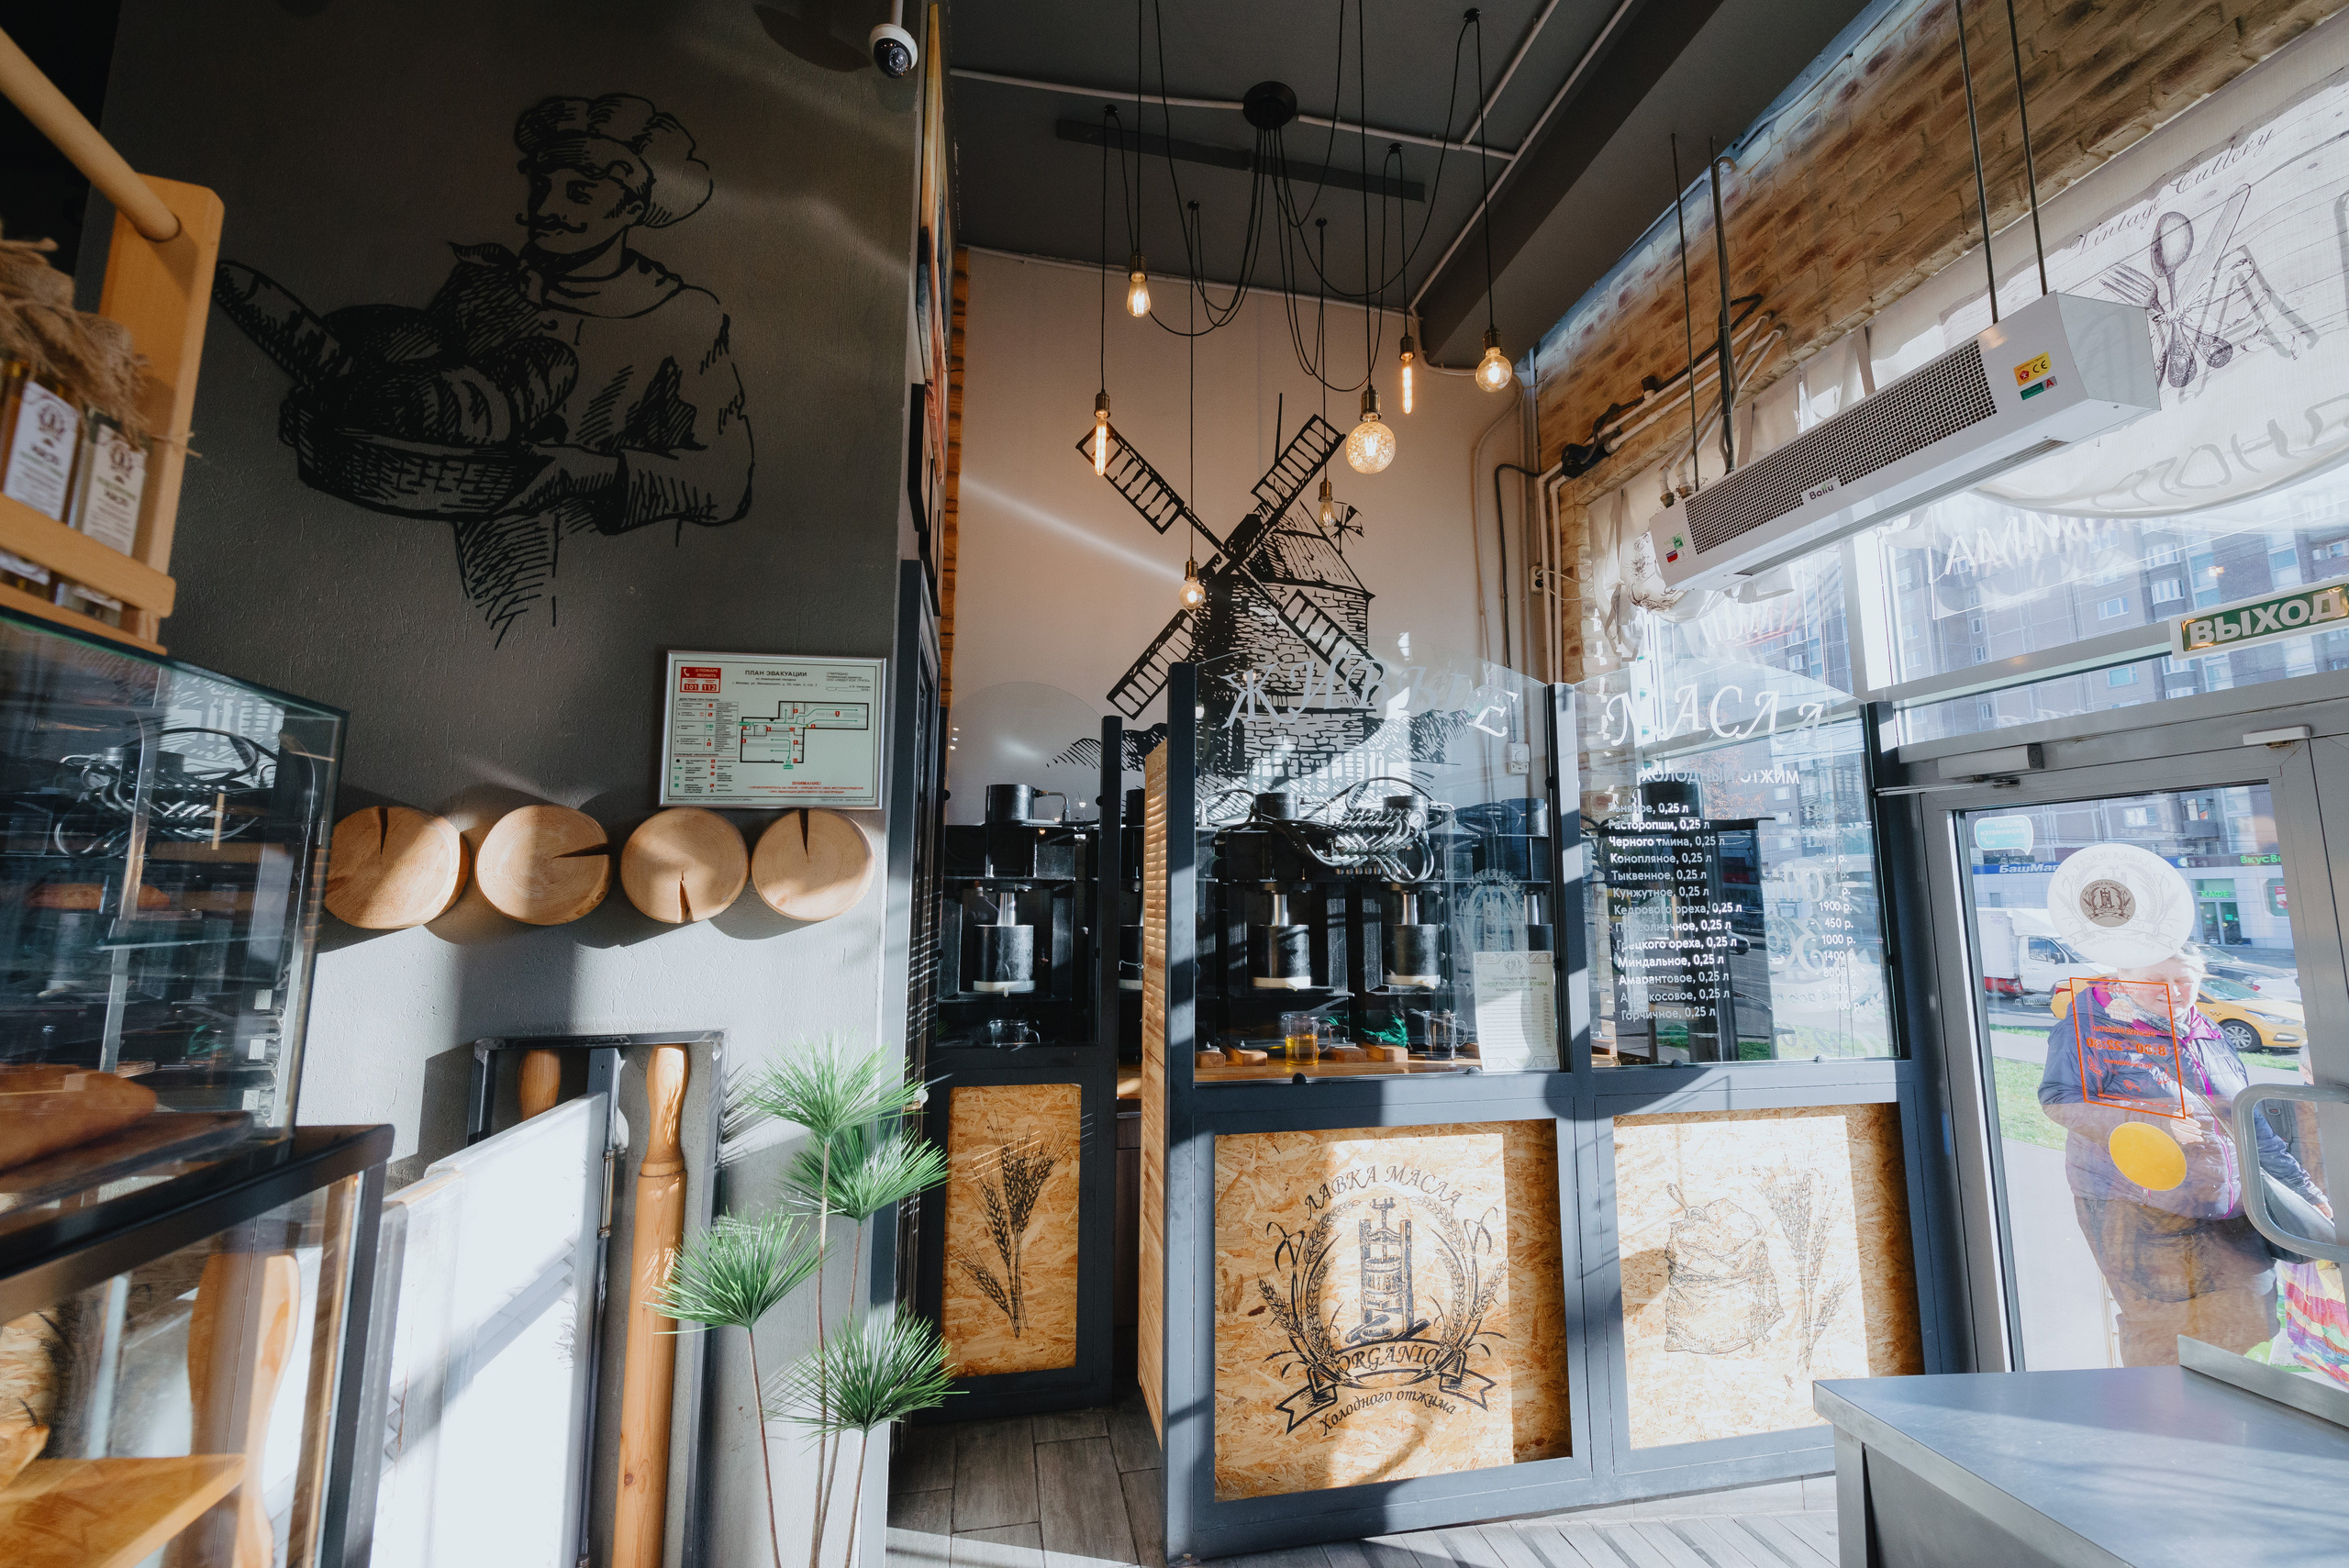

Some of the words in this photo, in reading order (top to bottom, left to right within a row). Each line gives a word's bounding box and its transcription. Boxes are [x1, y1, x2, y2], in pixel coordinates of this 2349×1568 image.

[2070, 197, 2160, 255] Vintage
[2169, 128, 2274, 194] Cutlery
[1809, 484, 1834, 500] Ballu
[2188, 591, 2344, 648] ВЫХОД
[1220, 651, 1519, 738] ЖИВЫЕ
[1606, 683, 1825, 749] МАСЛА
[1658, 803, 1680, 815] 0,25
[1608, 819, 1677, 832] Расторопши,
[1679, 819, 1701, 831] 0,25
[1609, 836, 1654, 849] Черного
[1655, 838, 1693, 848] тмина,
[1695, 836, 1717, 848] 0,25
[1609, 852, 1679, 864] Конопляное,
[1681, 852, 1703, 864] 0,25
[1611, 870, 1674, 881] Тыквенное,
[1676, 869, 1698, 881] 0,25
[1612, 887, 1676, 901] Кунжутное,
[1678, 886, 1700, 898] 0,25
[2200, 890, 2230, 898] КАФЕ
[1614, 905, 1672, 917] Кедрового
[1675, 905, 1710, 917] ореха,
[1711, 903, 1733, 915] 0,25
[1819, 901, 1842, 911] 1900
[1700, 919, 1722, 931] 0,25
[1824, 917, 1842, 929] 450
[1616, 940, 1666, 953] Грецкого
[1668, 939, 1705, 951] ореха,
[1706, 937, 1728, 949] 0,25
[1821, 934, 1844, 945] 1000
[1617, 956, 1691, 969] Миндальное,
[1693, 954, 1715, 966] 0,25
[1823, 951, 1845, 962] 1400
[1619, 973, 1697, 986] Амарантовое,
[1698, 972, 1720, 984] 0,25
[1698, 989, 1720, 1001] 0,25
[1621, 1008, 1682, 1023] Горчичное,
[1684, 1006, 1707, 1018] 0,25
[1304, 1164, 1377, 1221] ЛАВКА
[1384, 1165, 1464, 1207] МАСЛА
[1319, 1390, 1393, 1437] Холодного
[1396, 1390, 1457, 1415] отжима
